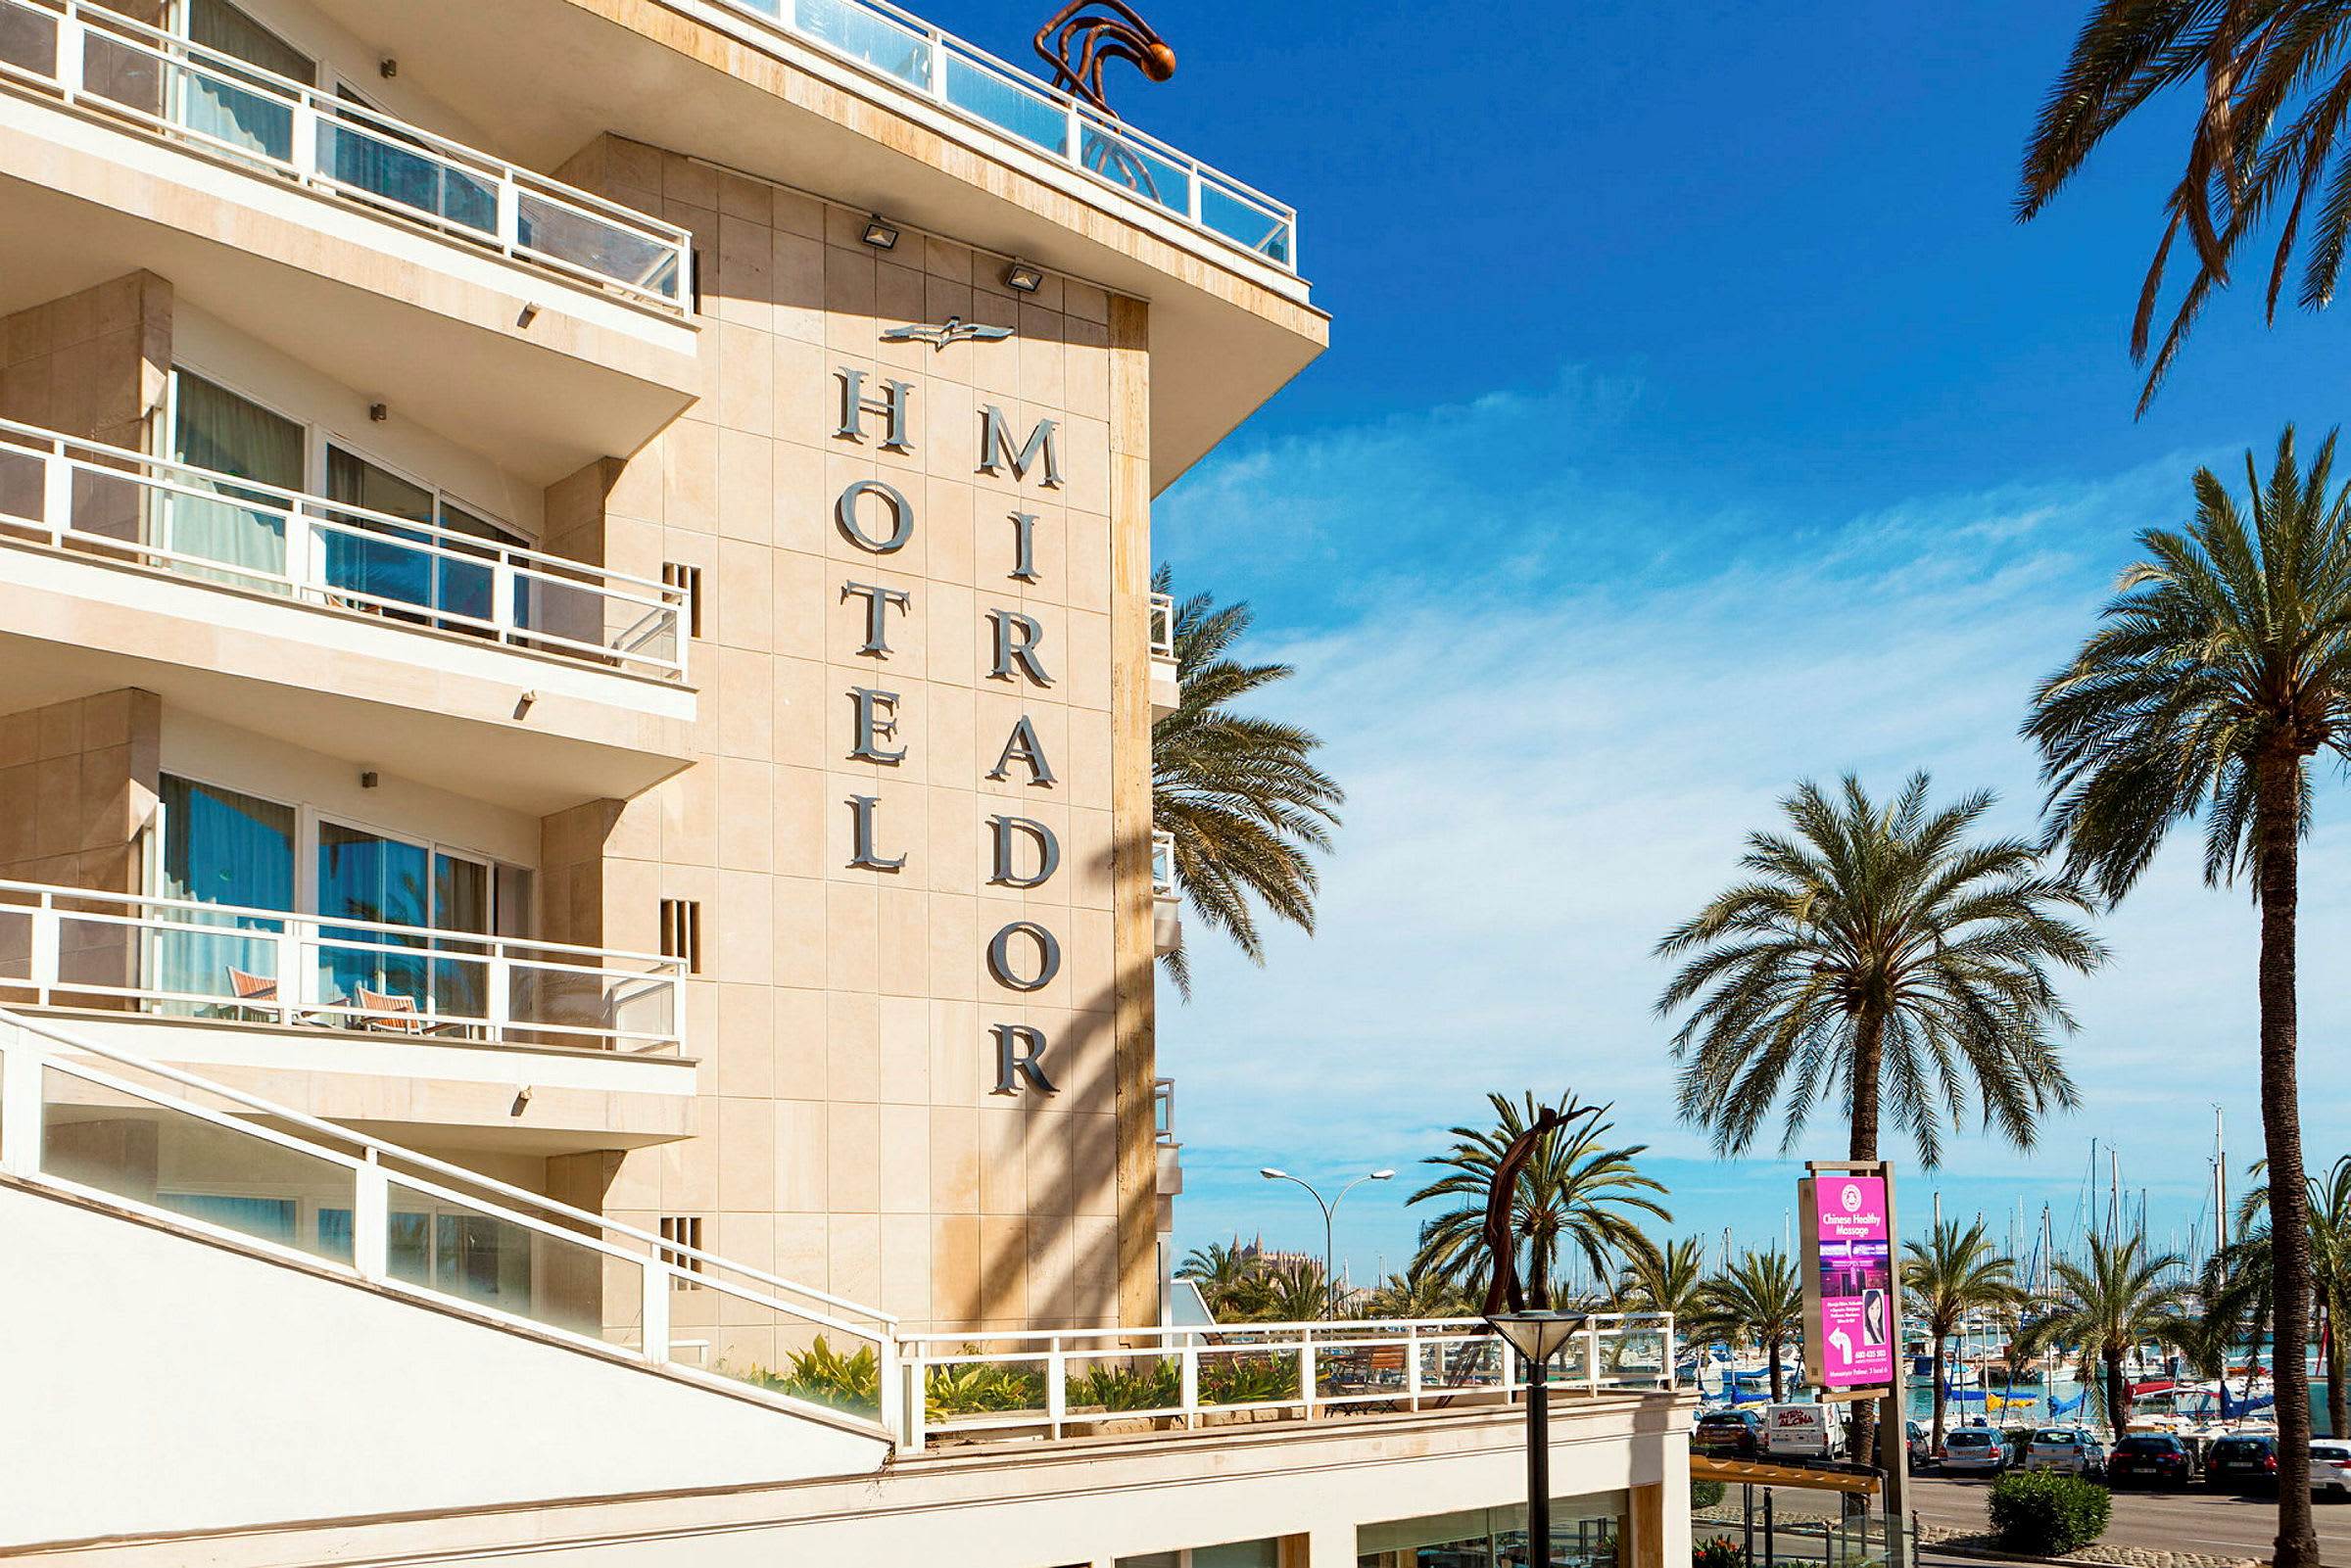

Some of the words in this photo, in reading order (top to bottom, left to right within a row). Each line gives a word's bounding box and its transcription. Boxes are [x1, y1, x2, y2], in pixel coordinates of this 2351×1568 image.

[832, 365, 916, 875] HOTEL
[974, 403, 1065, 1099] MIRADOR
[1823, 1212, 1851, 1224] Chinese
[1852, 1212, 1881, 1227] Healthy
[1836, 1224, 1869, 1238] Massage
[1778, 1409, 1804, 1420] AUTOS
[1779, 1415, 1814, 1428] ALCINA
